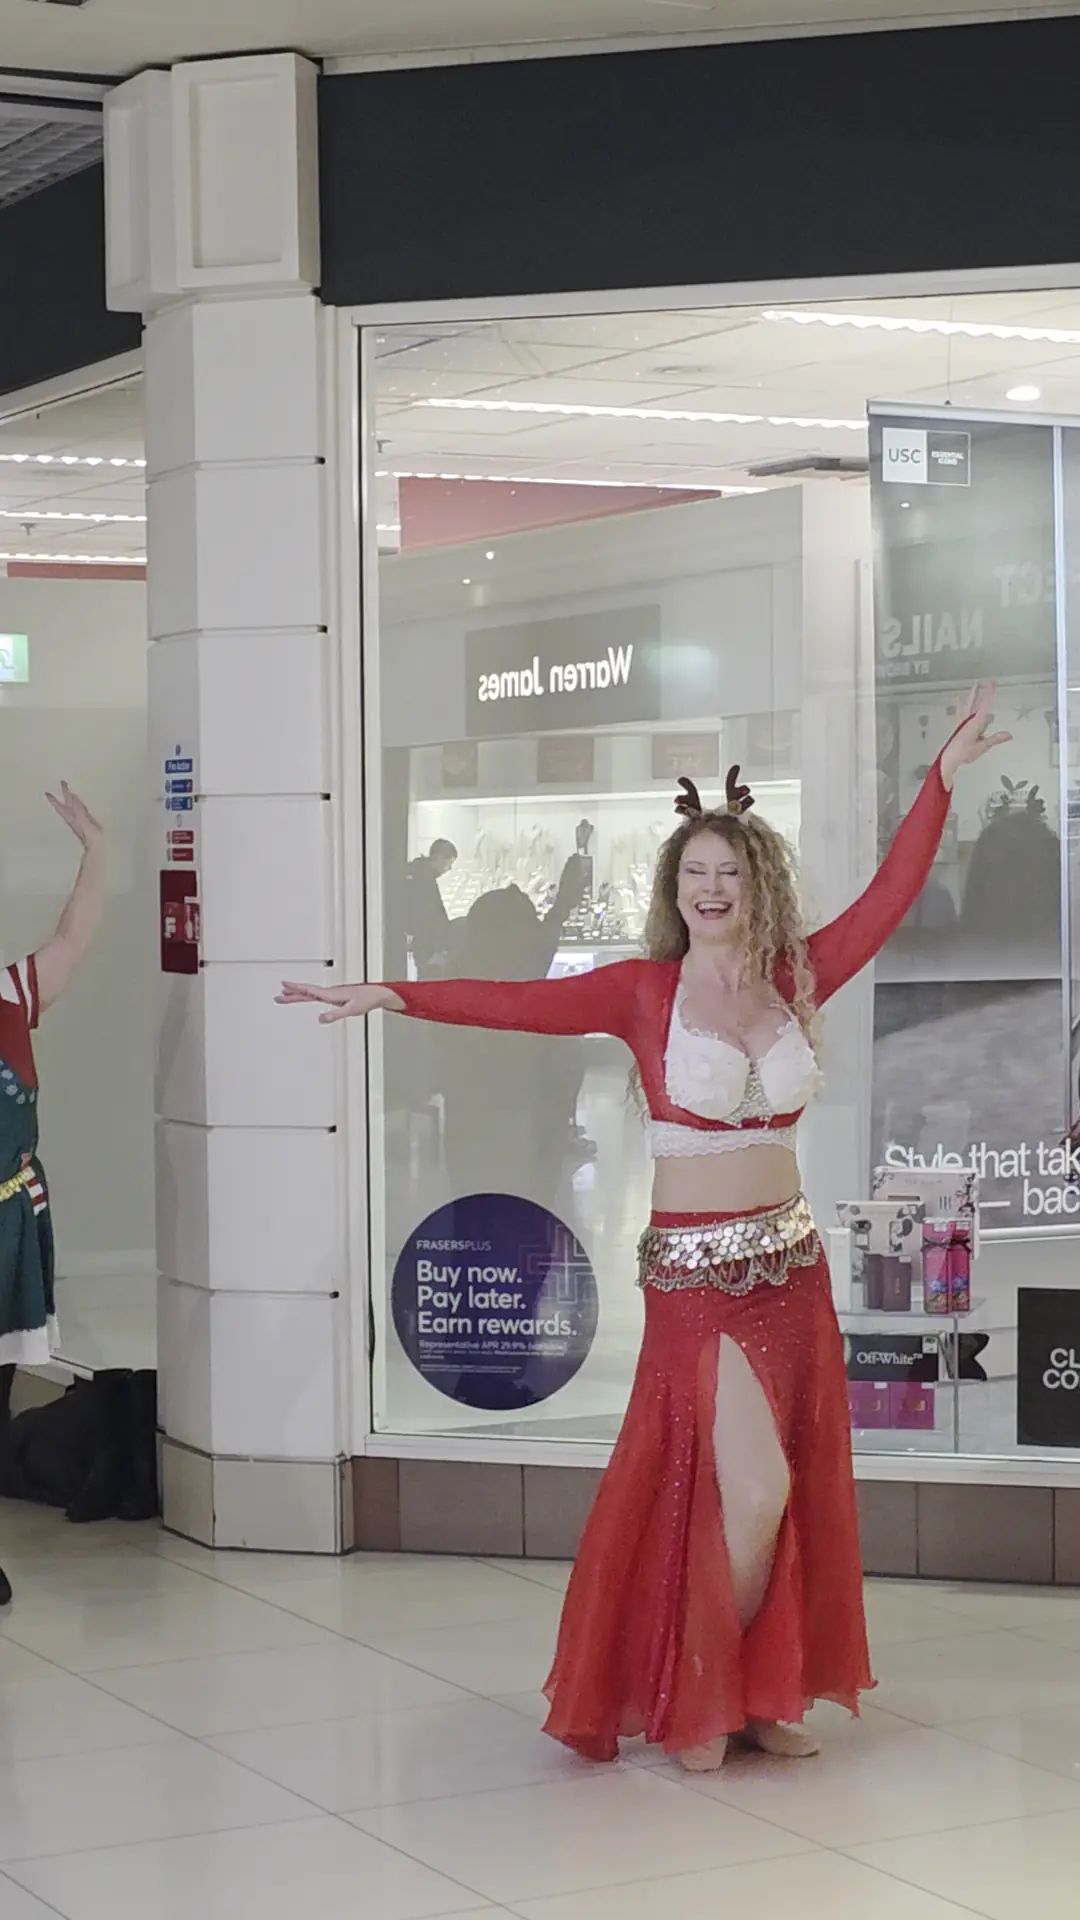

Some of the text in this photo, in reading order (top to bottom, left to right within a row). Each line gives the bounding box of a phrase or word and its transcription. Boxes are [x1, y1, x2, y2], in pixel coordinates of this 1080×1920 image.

[888, 448, 922, 464] USC
[969, 1141, 1031, 1179] that
[1023, 1178, 1080, 1216] bac
[416, 1259, 523, 1288] Buy now.
[418, 1285, 526, 1314] Pay later.
[418, 1311, 578, 1336] Earn rewards.
[481, 1340, 499, 1350] APR
[1050, 1348, 1080, 1368] CL
[1043, 1368, 1080, 1390] CO
